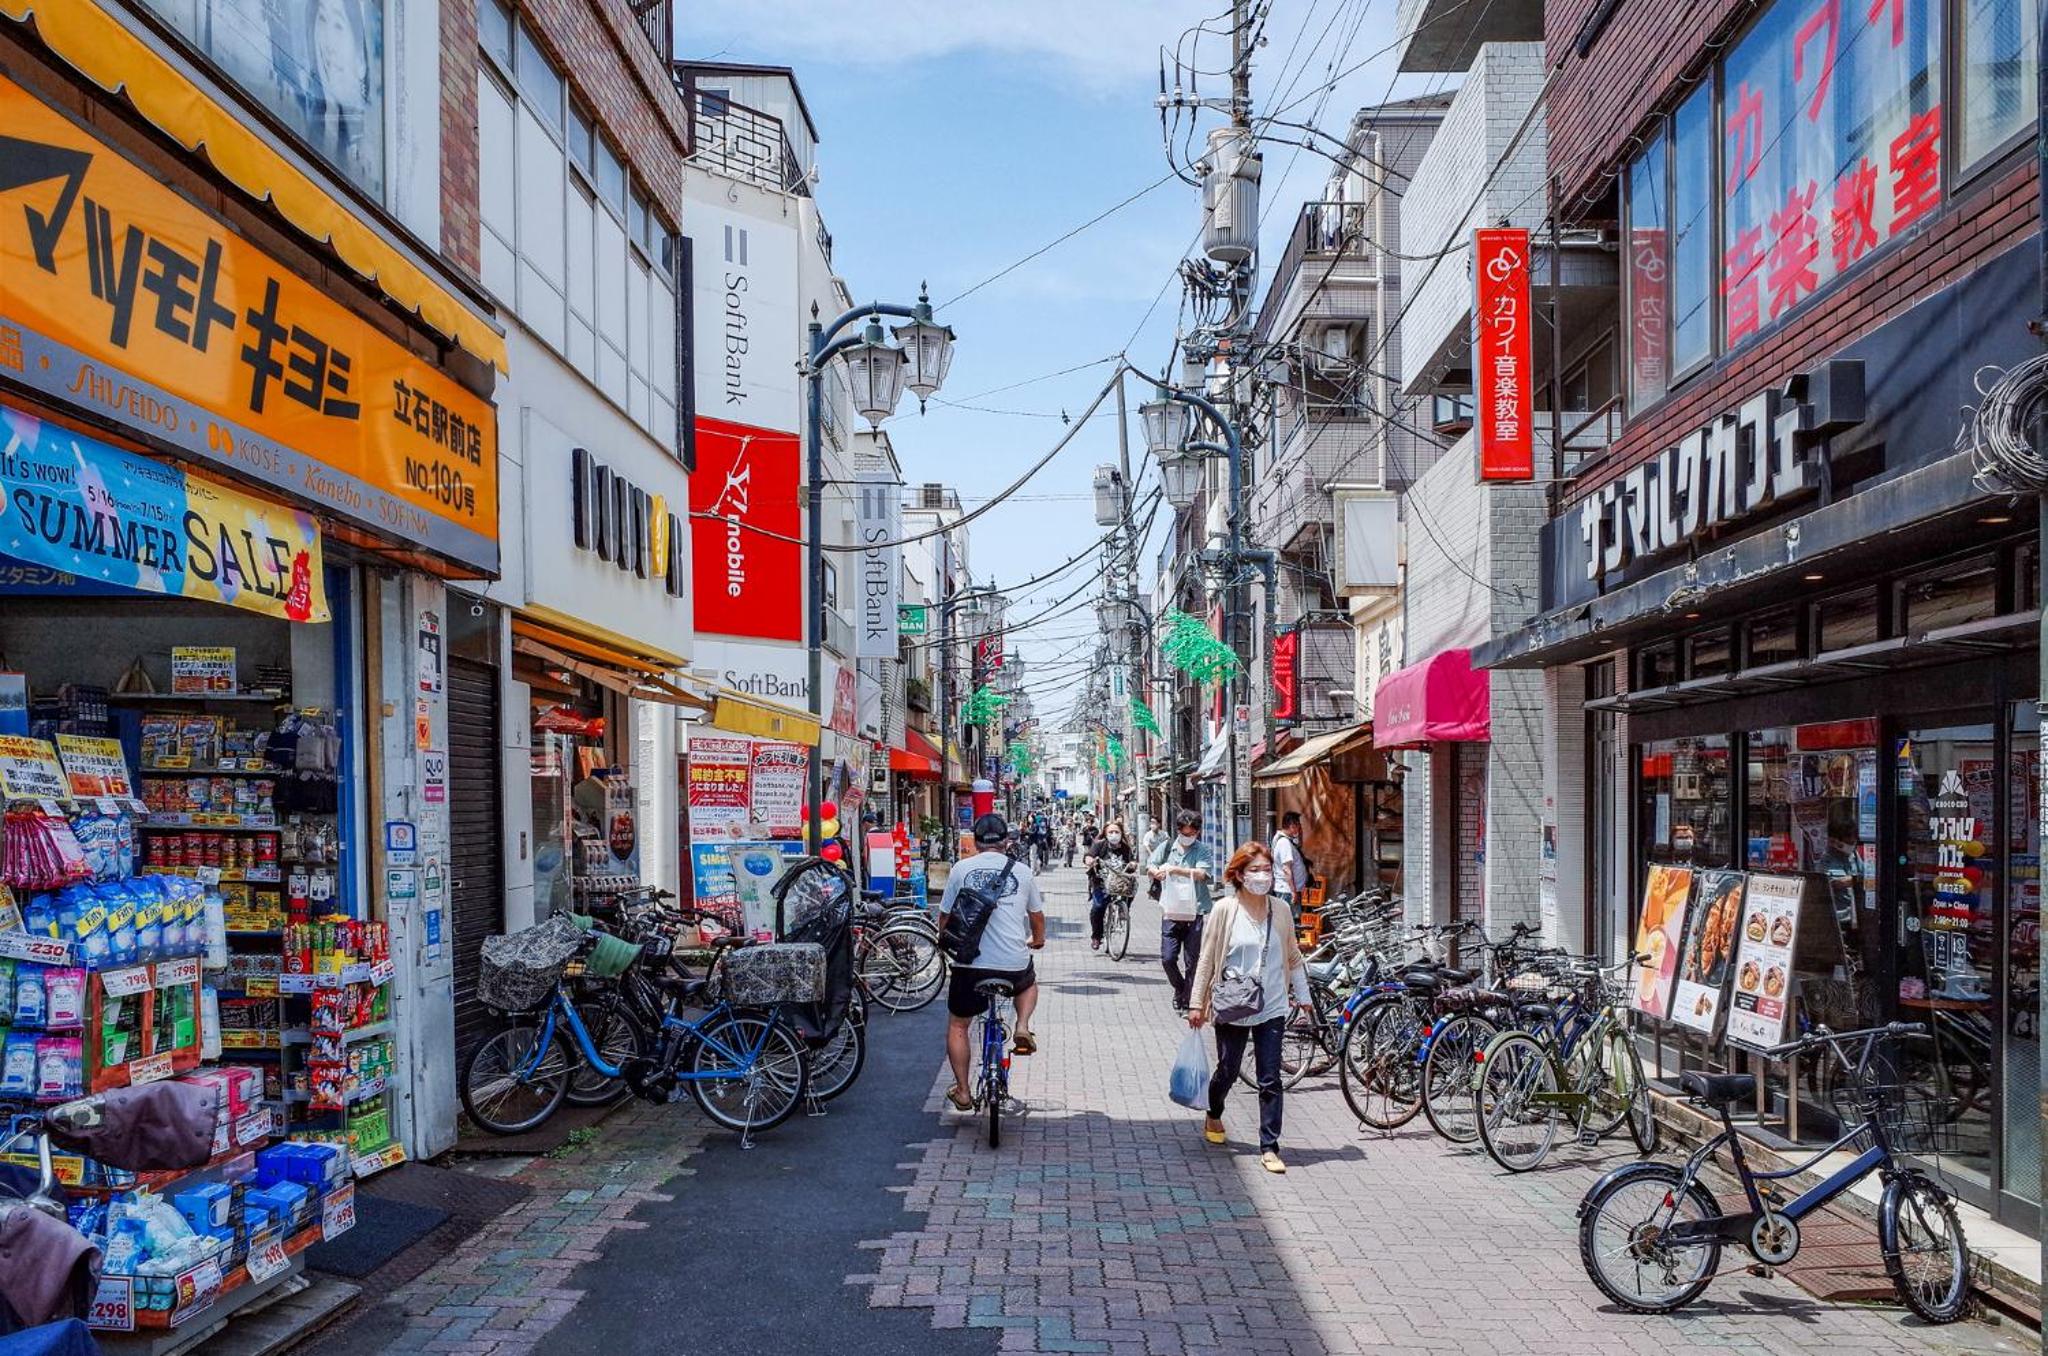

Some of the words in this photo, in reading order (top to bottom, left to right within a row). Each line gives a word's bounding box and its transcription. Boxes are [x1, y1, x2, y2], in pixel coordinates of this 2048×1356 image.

[1719, 104, 1941, 350] 音楽教室
[0, 135, 361, 421] マツモトキヨシ
[724, 271, 750, 406] SoftBank
[1493, 294, 1520, 442] カワイ音楽教室
[66, 363, 179, 432] SHISEIDO
[393, 378, 482, 467] 立石駅前店
[1, 455, 29, 479] It's
[34, 463, 77, 485] wow!
[239, 438, 281, 475] KOSÉ
[303, 463, 362, 509] Kanebo
[378, 495, 430, 537] SOFINA
[12, 488, 185, 574] SUMMER
[182, 510, 292, 600] SALE
[863, 527, 889, 641] SoftBank
[724, 670, 810, 698] SoftBank
[425, 758, 443, 777] QUO
[1929, 816, 1975, 841] サンマルク
[1938, 844, 1965, 868] カフェ
[95, 1303, 127, 1318] 298
